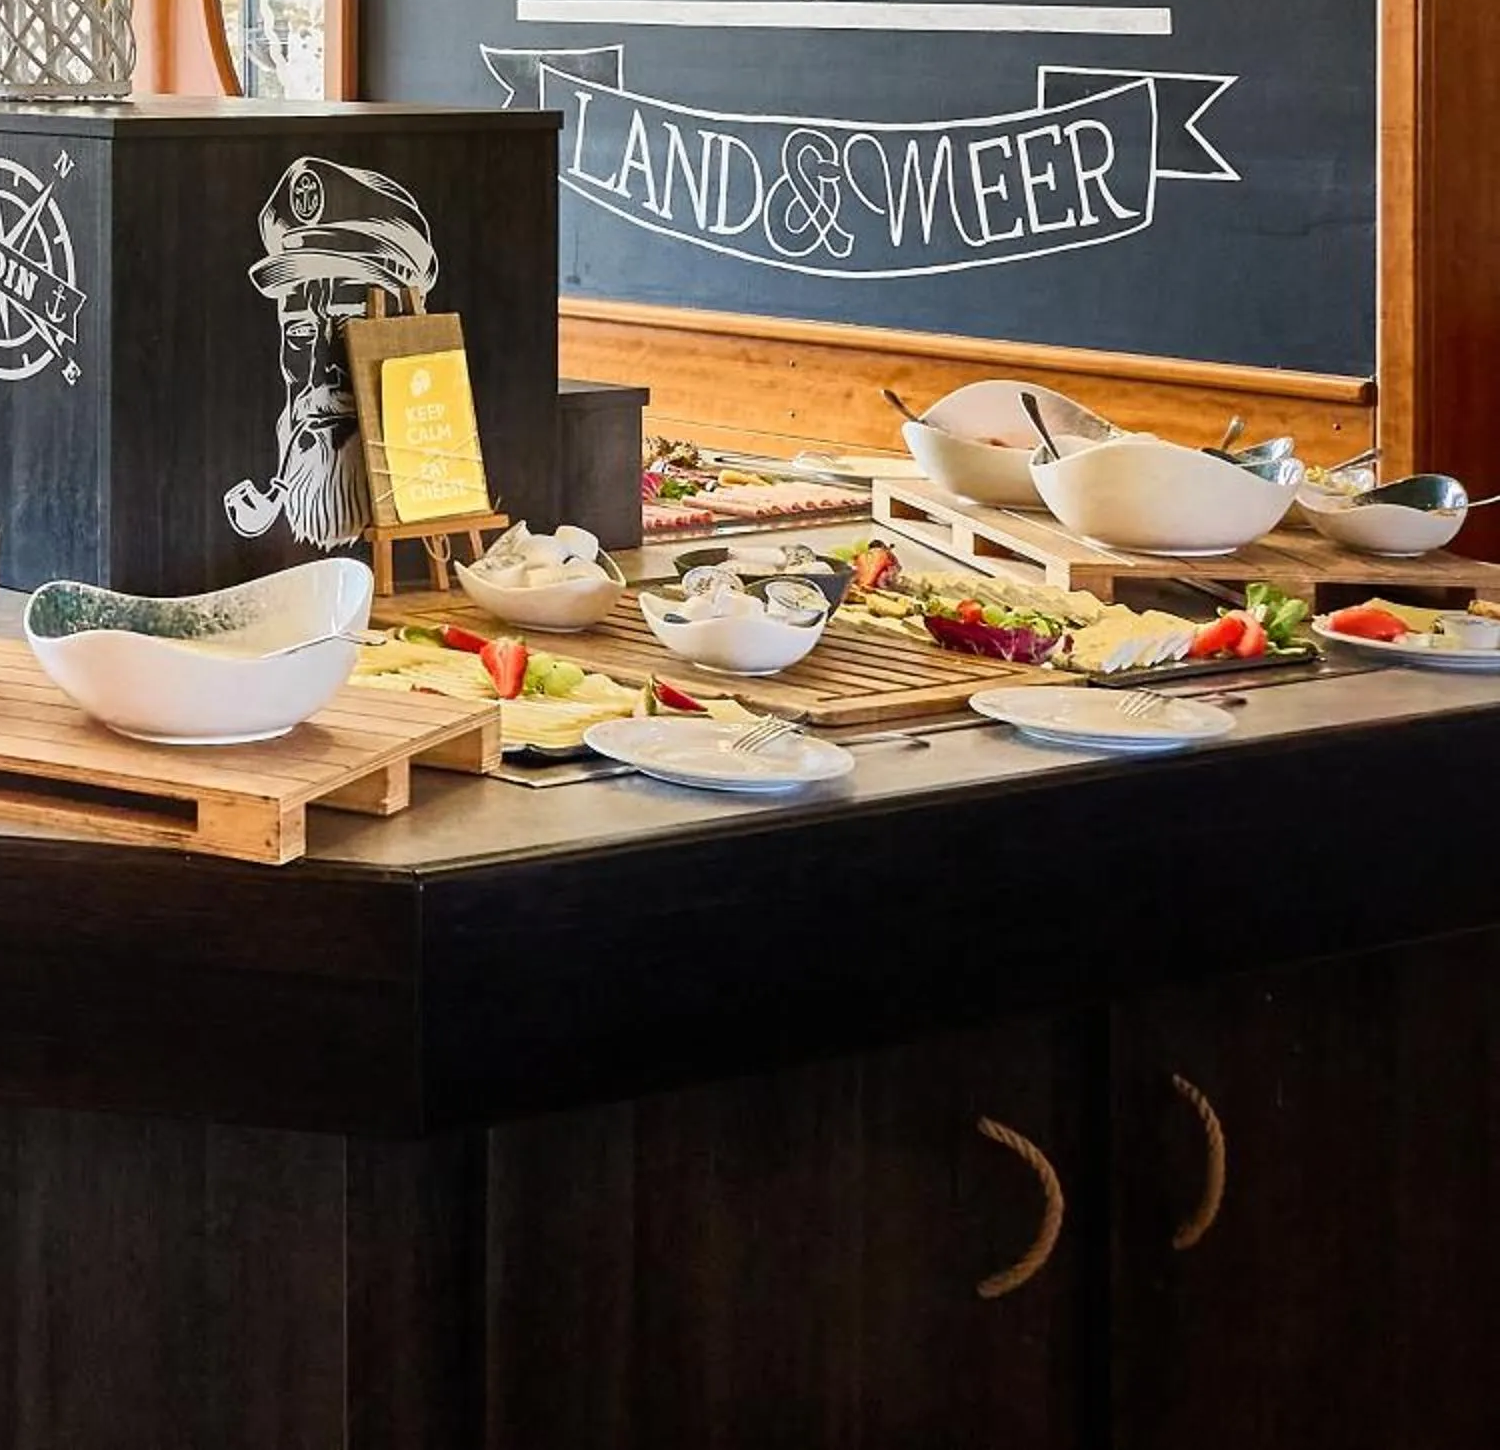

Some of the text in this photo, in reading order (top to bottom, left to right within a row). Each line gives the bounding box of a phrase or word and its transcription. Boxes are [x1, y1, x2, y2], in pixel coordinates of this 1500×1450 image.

[53, 150, 75, 179] N
[567, 91, 763, 235] LAND
[843, 119, 1140, 247] MEER
[62, 357, 82, 386] E
[405, 403, 446, 422] KEEP
[407, 423, 453, 444] CALM
